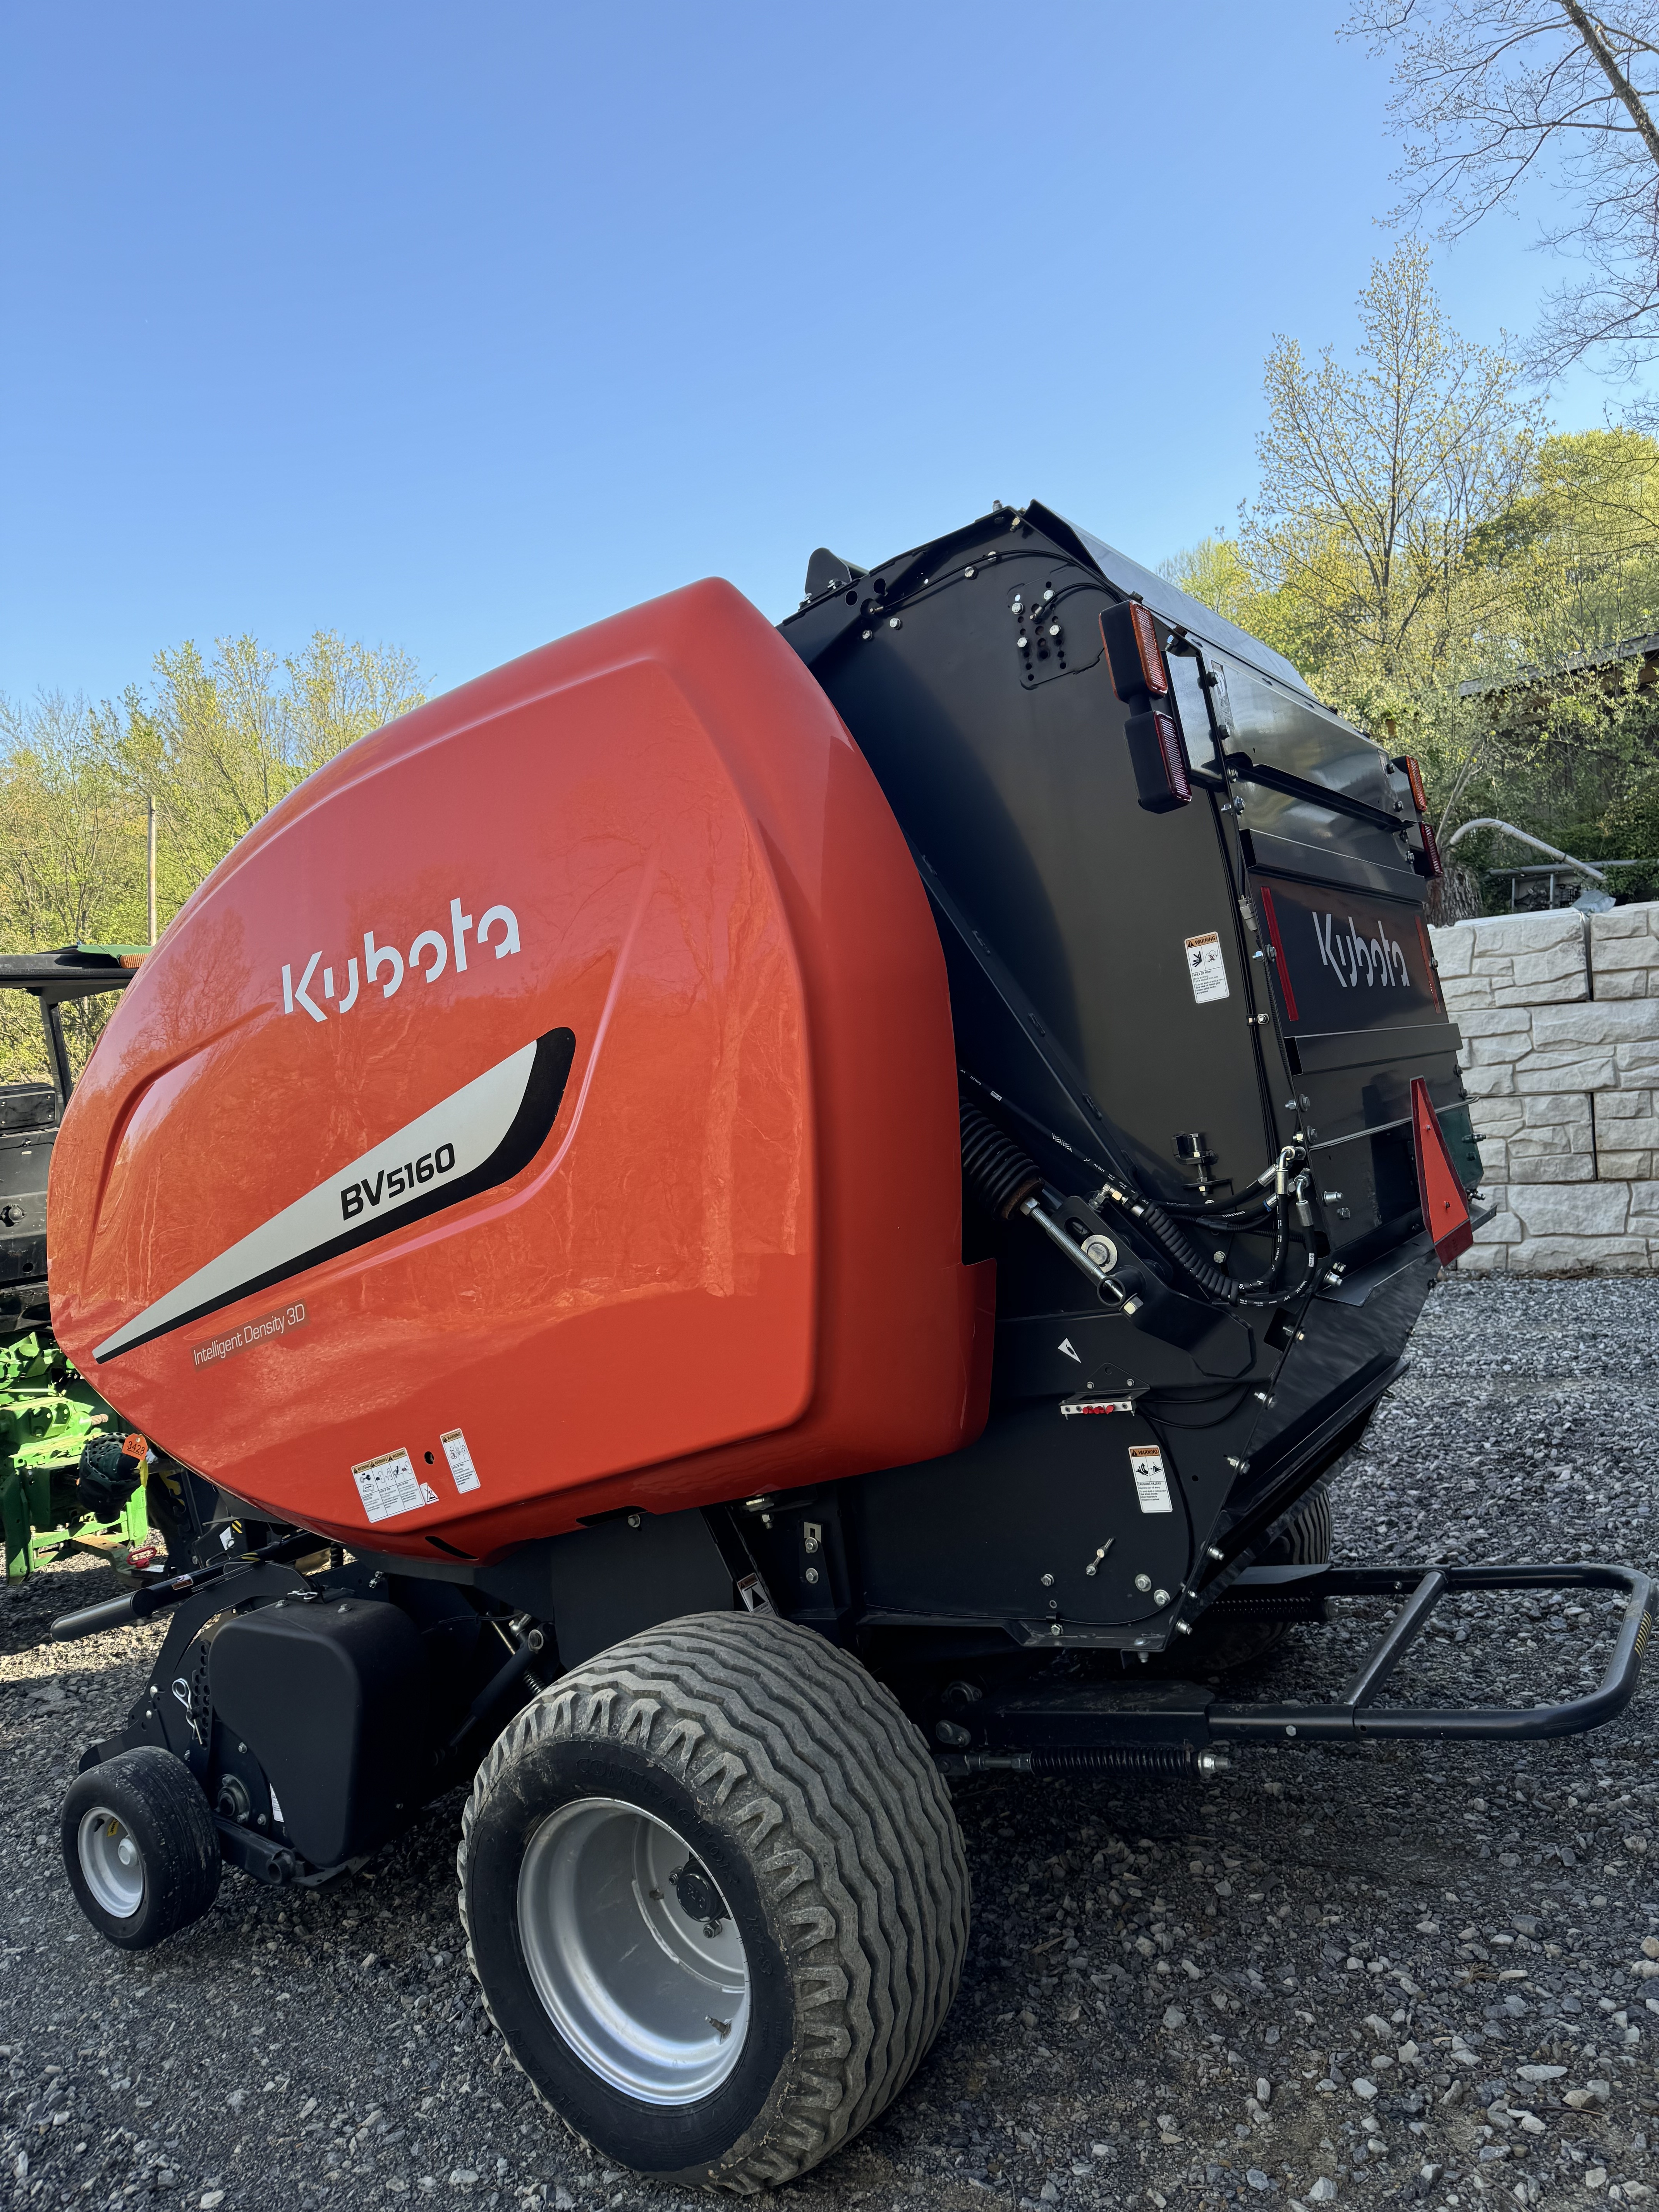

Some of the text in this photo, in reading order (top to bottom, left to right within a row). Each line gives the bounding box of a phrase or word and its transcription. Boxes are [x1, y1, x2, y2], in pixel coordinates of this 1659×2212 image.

[282, 898, 521, 1022] Kubota
[1195, 936, 1216, 945] WARNING
[1312, 912, 1410, 987] Kubota
[340, 1143, 455, 1221] BV5160
[194, 1304, 305, 1365] Intelligent Density 3D
[127, 1441, 145, 1455] 3428
